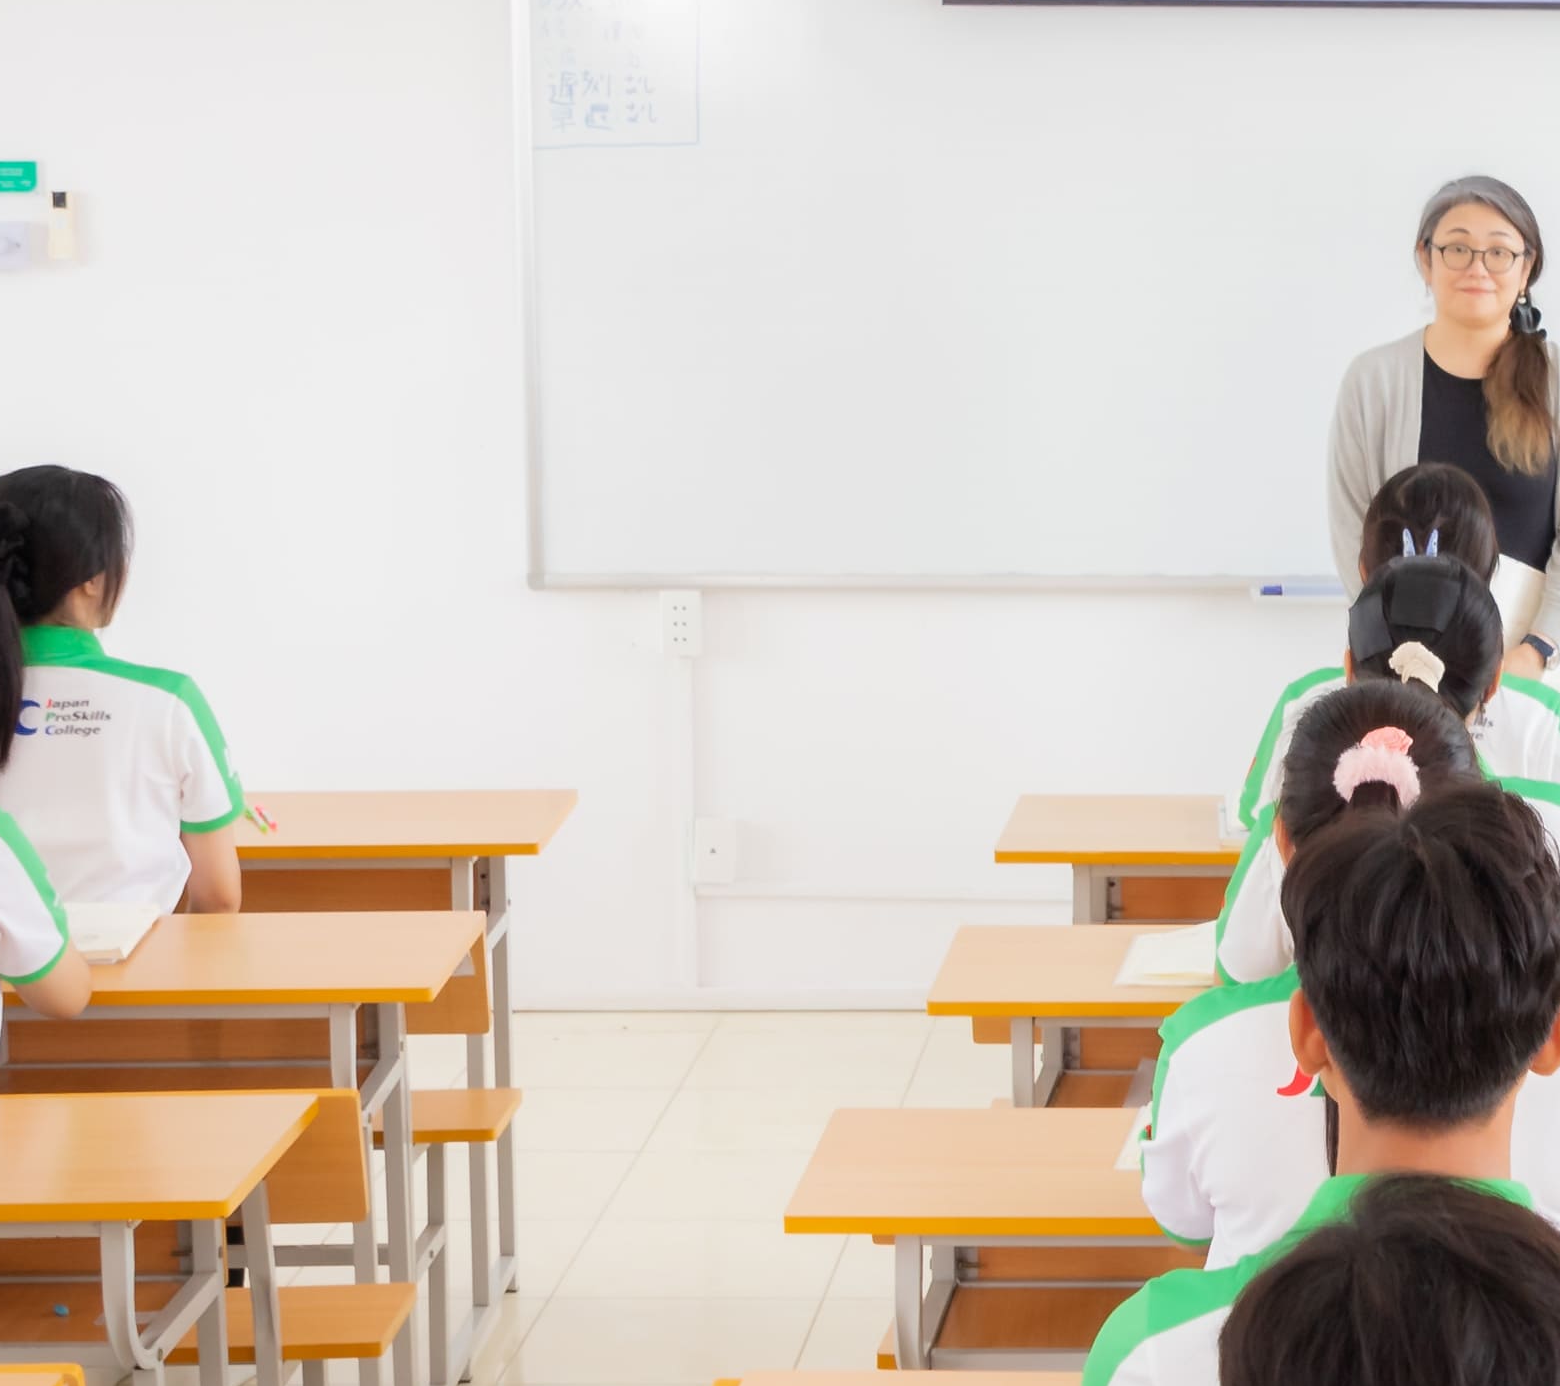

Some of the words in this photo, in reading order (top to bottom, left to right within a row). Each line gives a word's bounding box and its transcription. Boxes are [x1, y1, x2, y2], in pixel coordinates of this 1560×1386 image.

[46, 698, 90, 710] Japan
[45, 711, 111, 722] ProSkills
[45, 725, 101, 737] College
